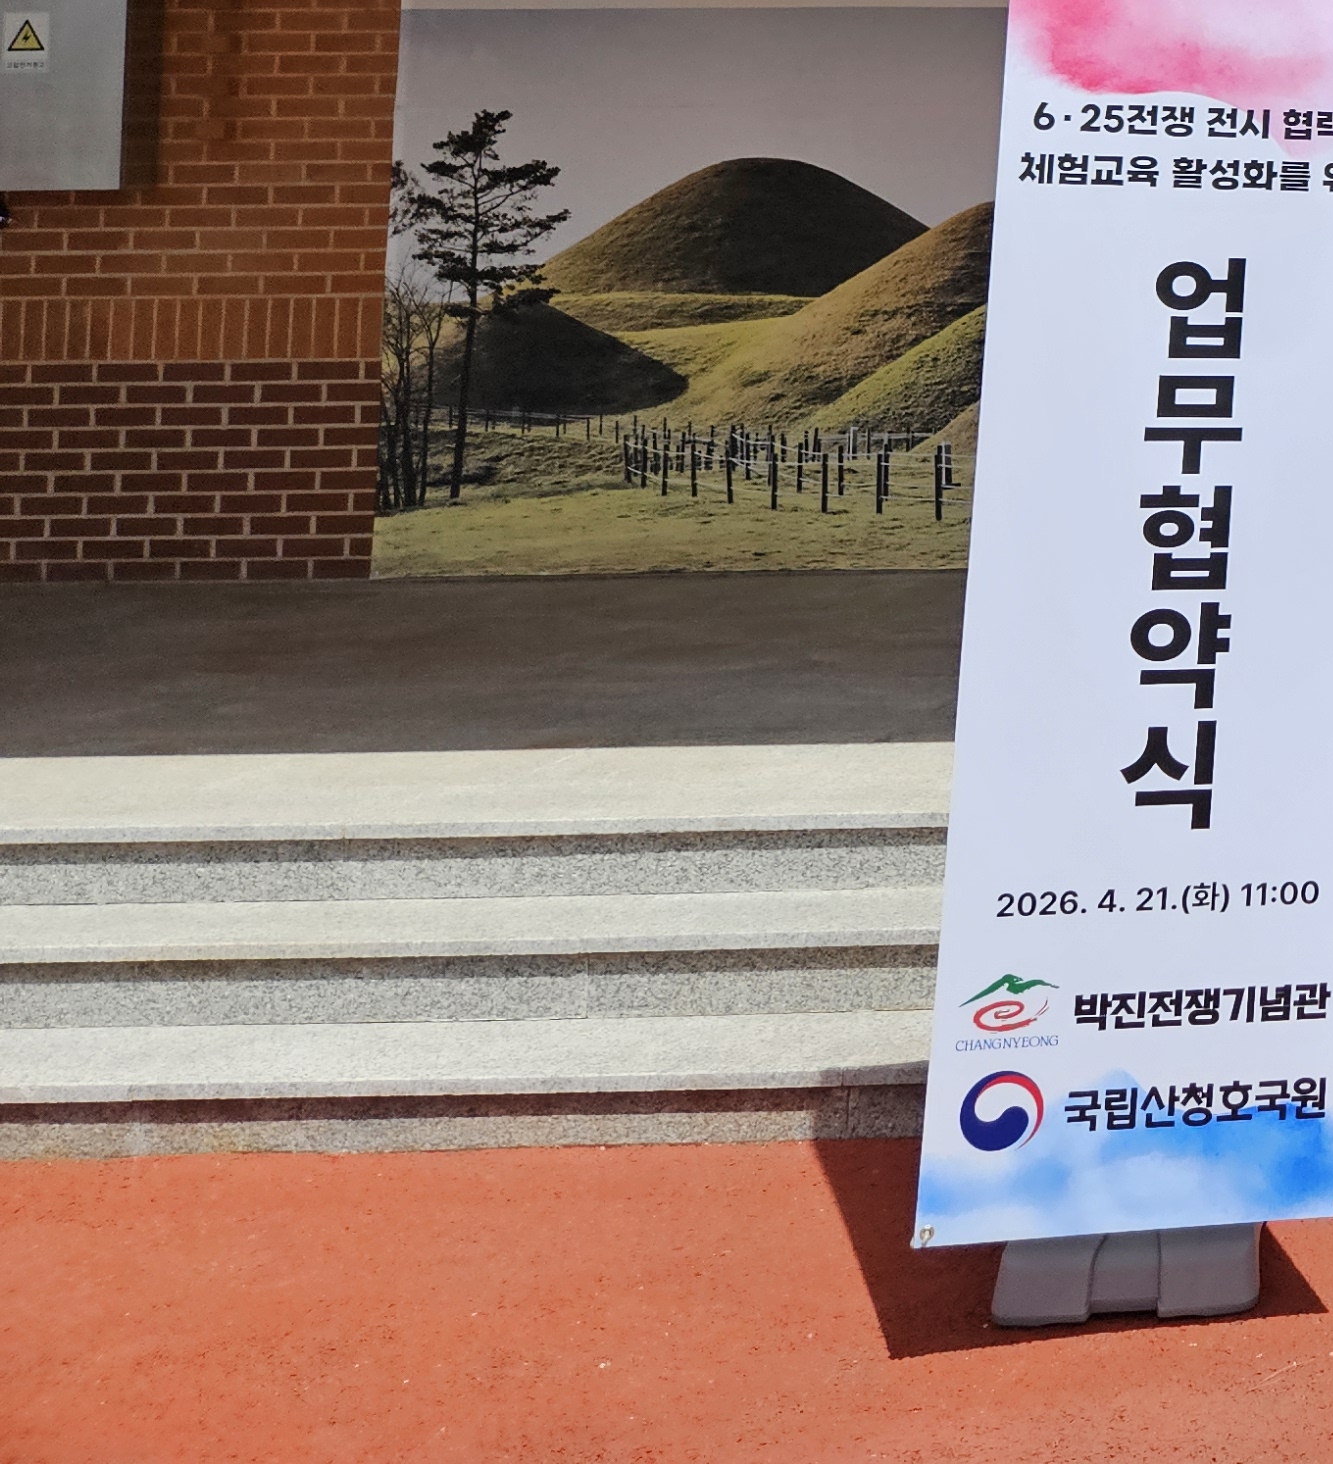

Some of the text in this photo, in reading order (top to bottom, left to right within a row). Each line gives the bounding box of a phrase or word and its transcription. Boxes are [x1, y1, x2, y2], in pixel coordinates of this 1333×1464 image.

[1032, 101, 1196, 138] 6·25전쟁
[1206, 107, 1271, 140] 전시
[1018, 151, 1160, 187] 체험교육
[1171, 156, 1311, 193] 활성화를
[1119, 257, 1247, 830] 업무협약식
[996, 880, 1320, 918] 2026. 4. 21.(화) 11:00
[1073, 982, 1332, 1032] 박진전쟁기념관
[955, 1034, 1059, 1052] CHANGNYEONG
[1064, 1076, 1327, 1132] 국립산청호국원
